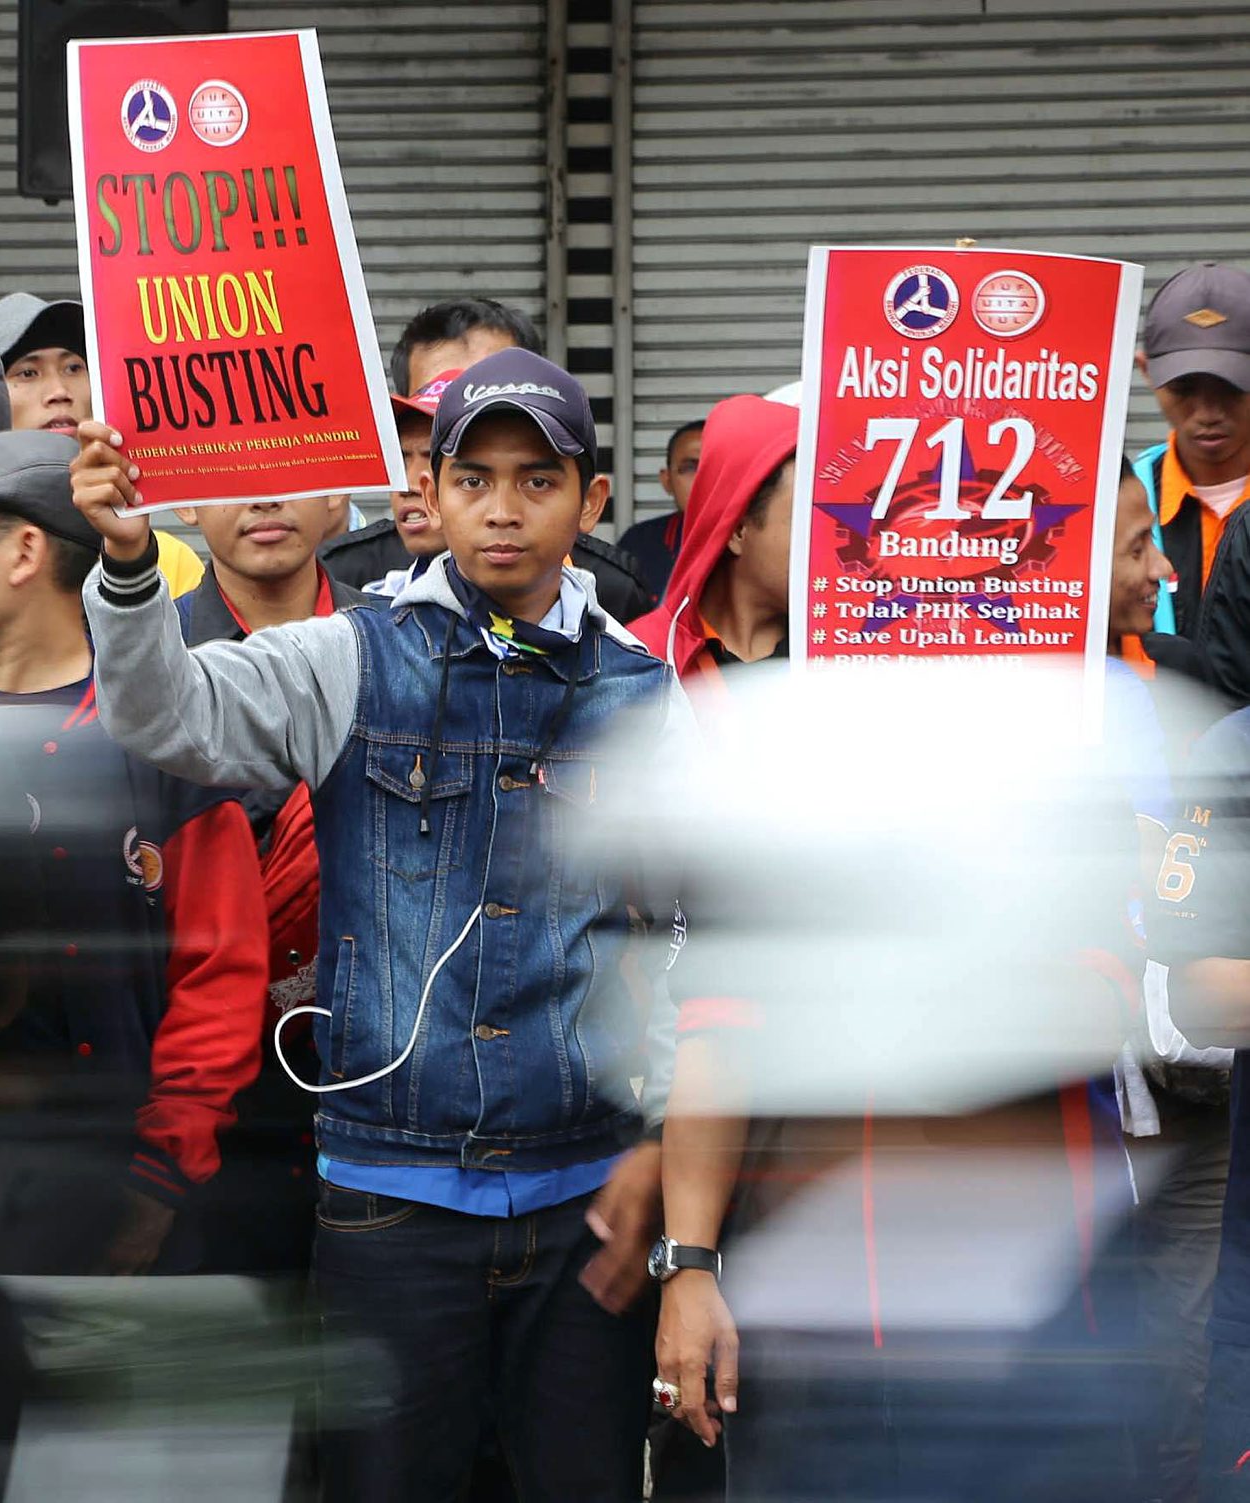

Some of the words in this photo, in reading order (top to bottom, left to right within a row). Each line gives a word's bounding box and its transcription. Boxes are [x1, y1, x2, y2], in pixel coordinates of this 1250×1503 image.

[96, 166, 308, 256] STOP!!!
[136, 270, 283, 344] UNION
[123, 343, 328, 432] BUSTING
[836, 346, 909, 398] Aksi
[919, 346, 1099, 401] Solidaritas
[464, 383, 567, 408] Vespa
[128, 444, 188, 459] FEDERASI
[191, 441, 242, 455] SERIKAT
[246, 435, 301, 451] PEKERJA
[304, 430, 360, 444] MANDIRI
[864, 416, 1037, 520] 712
[879, 530, 1020, 564] Bandung
[835, 576, 894, 598] Stop
[900, 576, 976, 593] Union
[983, 576, 1084, 598] Busting
[835, 602, 908, 619] Tolak
[915, 602, 972, 620] PHK
[977, 602, 1081, 624] Sepihak
[834, 629, 892, 645] Save
[900, 629, 966, 648] Upah
[974, 628, 1075, 646] Lembur
